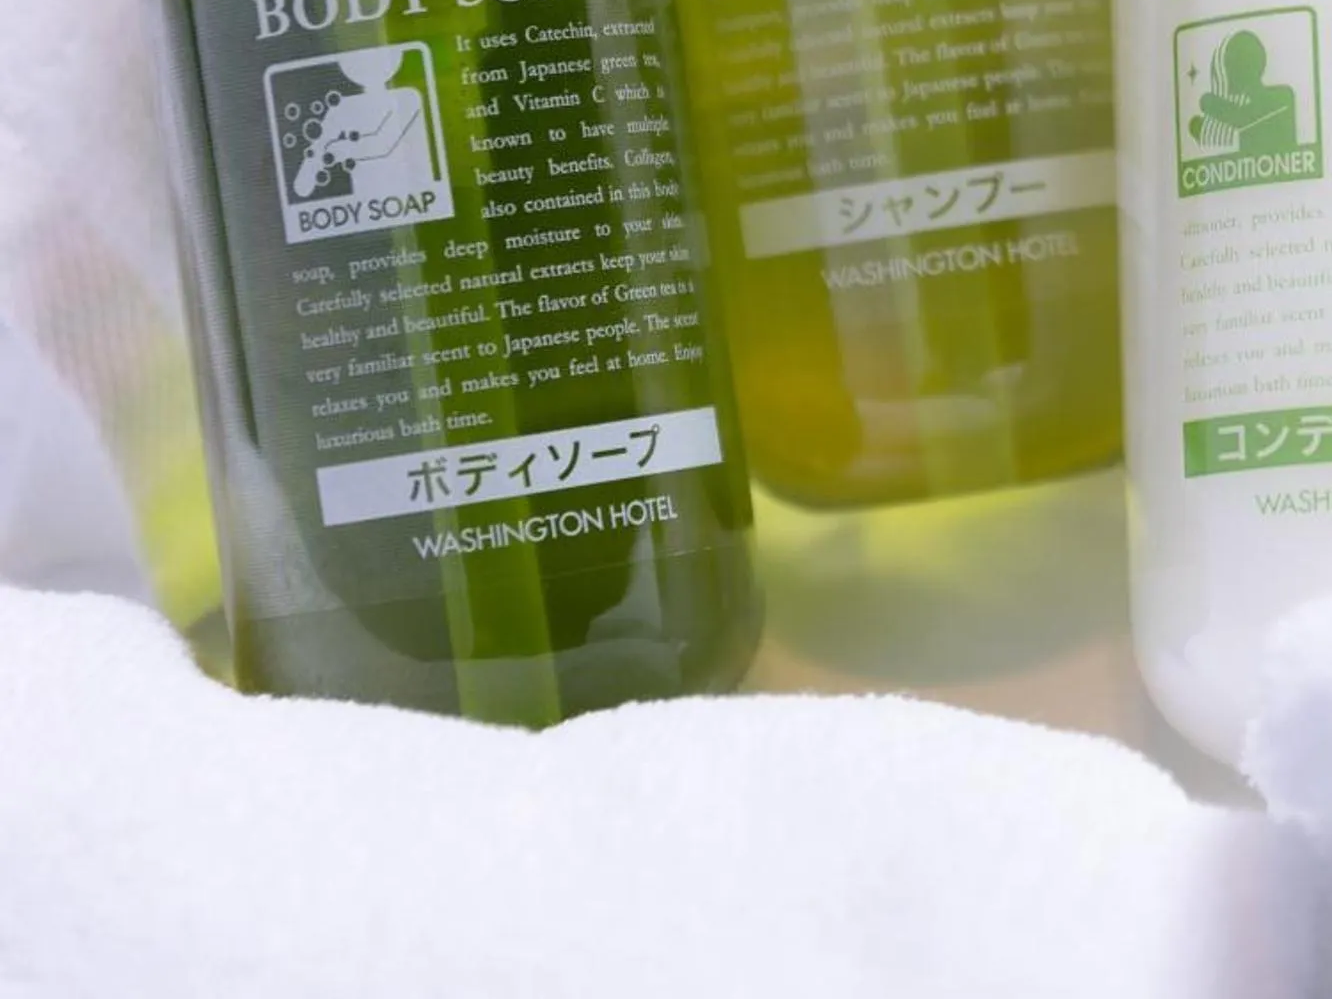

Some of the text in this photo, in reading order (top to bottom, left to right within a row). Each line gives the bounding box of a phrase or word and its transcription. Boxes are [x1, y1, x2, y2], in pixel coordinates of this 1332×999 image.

[456, 35, 472, 52] It
[479, 31, 518, 50] uses
[525, 20, 598, 44] Catechin,
[460, 66, 509, 85] from
[519, 58, 591, 84] Japanese
[600, 54, 637, 74] green
[465, 98, 500, 119] and
[512, 89, 581, 112] Vitamin
[592, 85, 605, 104] C
[615, 82, 650, 102] which
[470, 131, 533, 152] known
[548, 128, 567, 143] to
[580, 120, 615, 138] have
[474, 164, 535, 186] beauty
[548, 153, 615, 176] benefits.
[1181, 151, 1316, 190] CONDITIONER
[299, 190, 436, 233] BODY SOAP
[480, 200, 517, 219] also
[523, 185, 605, 213] contained
[608, 185, 624, 202] in
[838, 171, 1045, 233] シャンプー
[292, 266, 335, 285] soap,
[349, 247, 427, 280] provides
[443, 239, 489, 261] deep
[505, 227, 581, 250] moisture
[595, 223, 611, 237] to
[623, 218, 652, 240] your
[822, 233, 1081, 290] WASHINGTON HOTEL
[296, 288, 372, 317] Carefully
[379, 275, 452, 302] selected
[459, 265, 524, 291] natural
[529, 258, 595, 280] extracts
[600, 253, 634, 273] keep
[638, 250, 666, 270] your
[1233, 274, 1262, 296] and
[300, 325, 360, 348] healthy
[365, 317, 399, 340] and
[402, 304, 492, 334] beautiful.
[494, 300, 533, 319] The
[538, 295, 587, 313] flavor
[591, 286, 610, 306] of
[614, 283, 656, 302] Green
[305, 366, 342, 385] very
[348, 352, 416, 377] familiar
[423, 344, 472, 365] scent
[477, 341, 497, 357] to
[503, 329, 580, 359] Japanese
[585, 318, 640, 346] people.
[644, 313, 670, 333] The
[312, 397, 368, 418] relaxes
[376, 391, 410, 413] you
[417, 377, 452, 400] and
[461, 370, 519, 394] makes
[528, 365, 561, 389] you
[569, 354, 599, 377] feel
[606, 356, 622, 372] at
[627, 349, 669, 369] home.
[315, 410, 493, 450] luxurious bath time.
[407, 424, 661, 503] ボディソープ
[412, 495, 678, 559] WASHINGTON HOTEL
